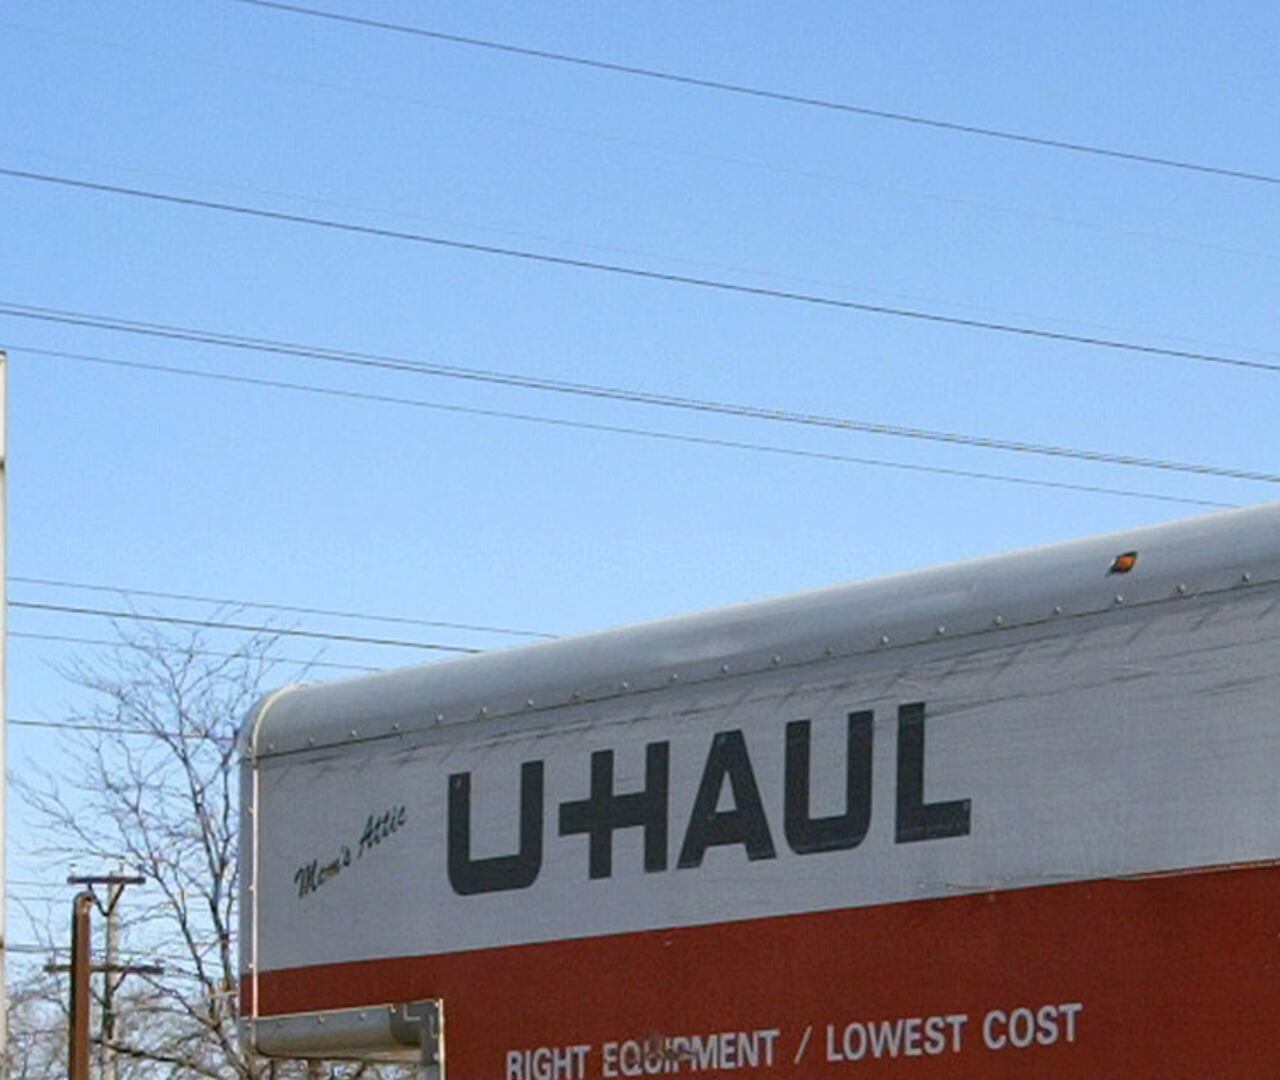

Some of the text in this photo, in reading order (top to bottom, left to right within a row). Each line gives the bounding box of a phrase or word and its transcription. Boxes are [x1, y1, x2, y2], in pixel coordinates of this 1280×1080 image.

[358, 805, 407, 859] Attic
[602, 1029, 780, 1078] EQUIPMENT
[826, 1014, 968, 1062] LOWEST
[982, 1003, 1083, 1050] COST
